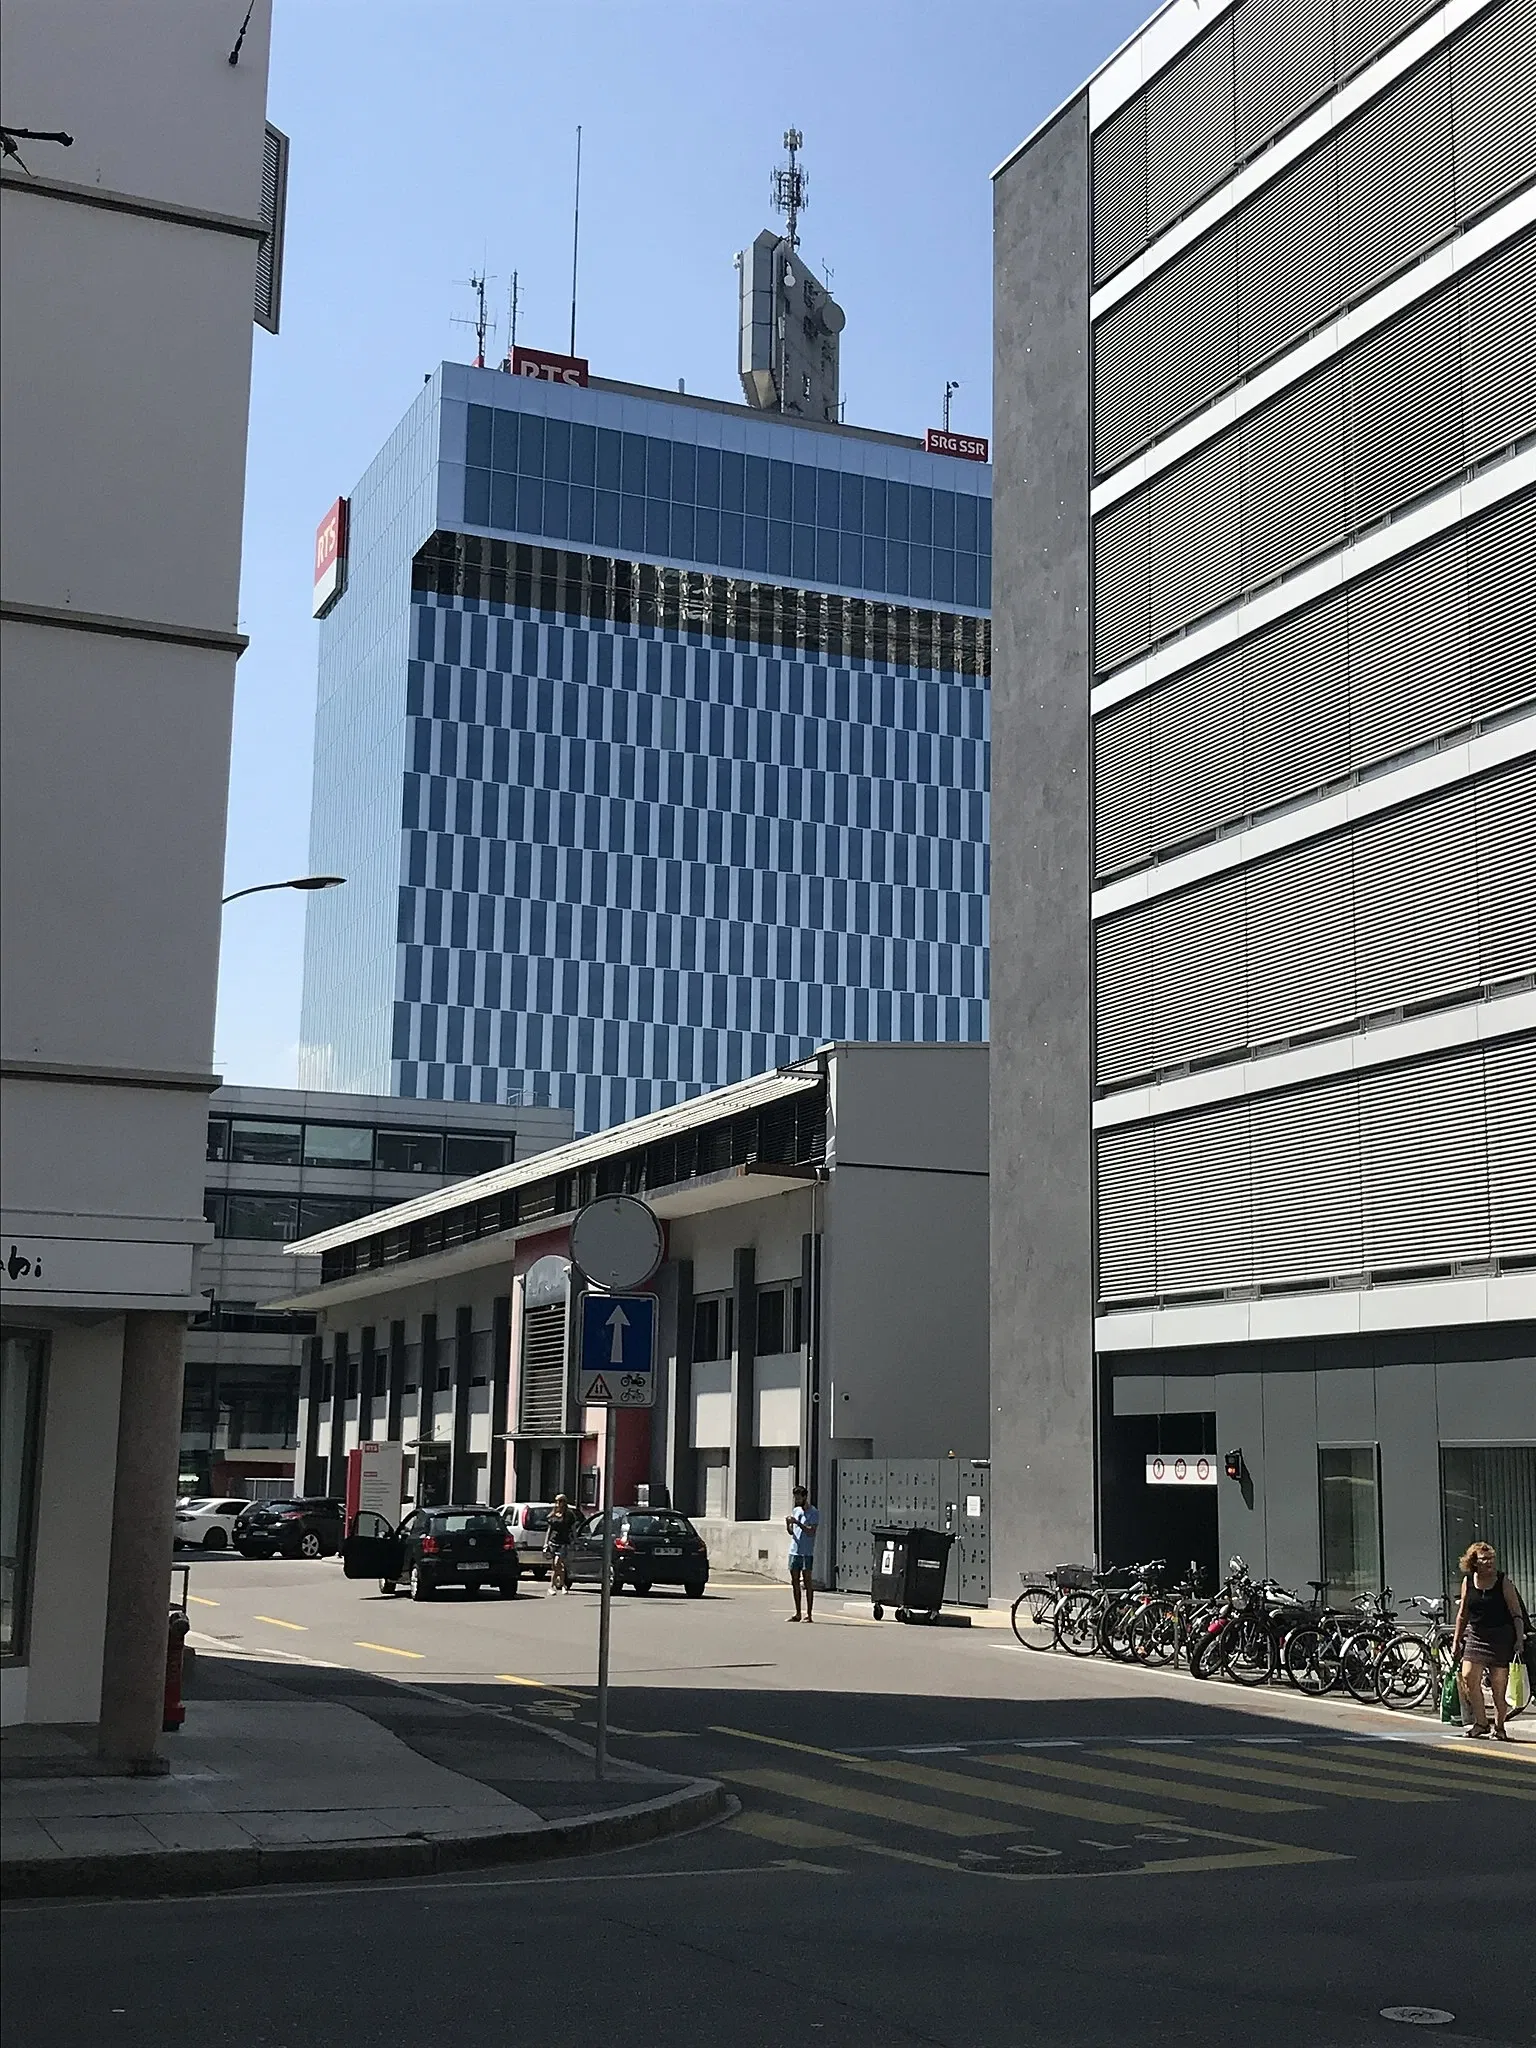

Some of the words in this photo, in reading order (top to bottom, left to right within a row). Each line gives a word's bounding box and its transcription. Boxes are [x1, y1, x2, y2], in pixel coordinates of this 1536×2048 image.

[521, 360, 580, 387] RTS
[931, 435, 957, 451] SRG
[959, 440, 985, 456] SSR
[317, 517, 337, 569] RTS
